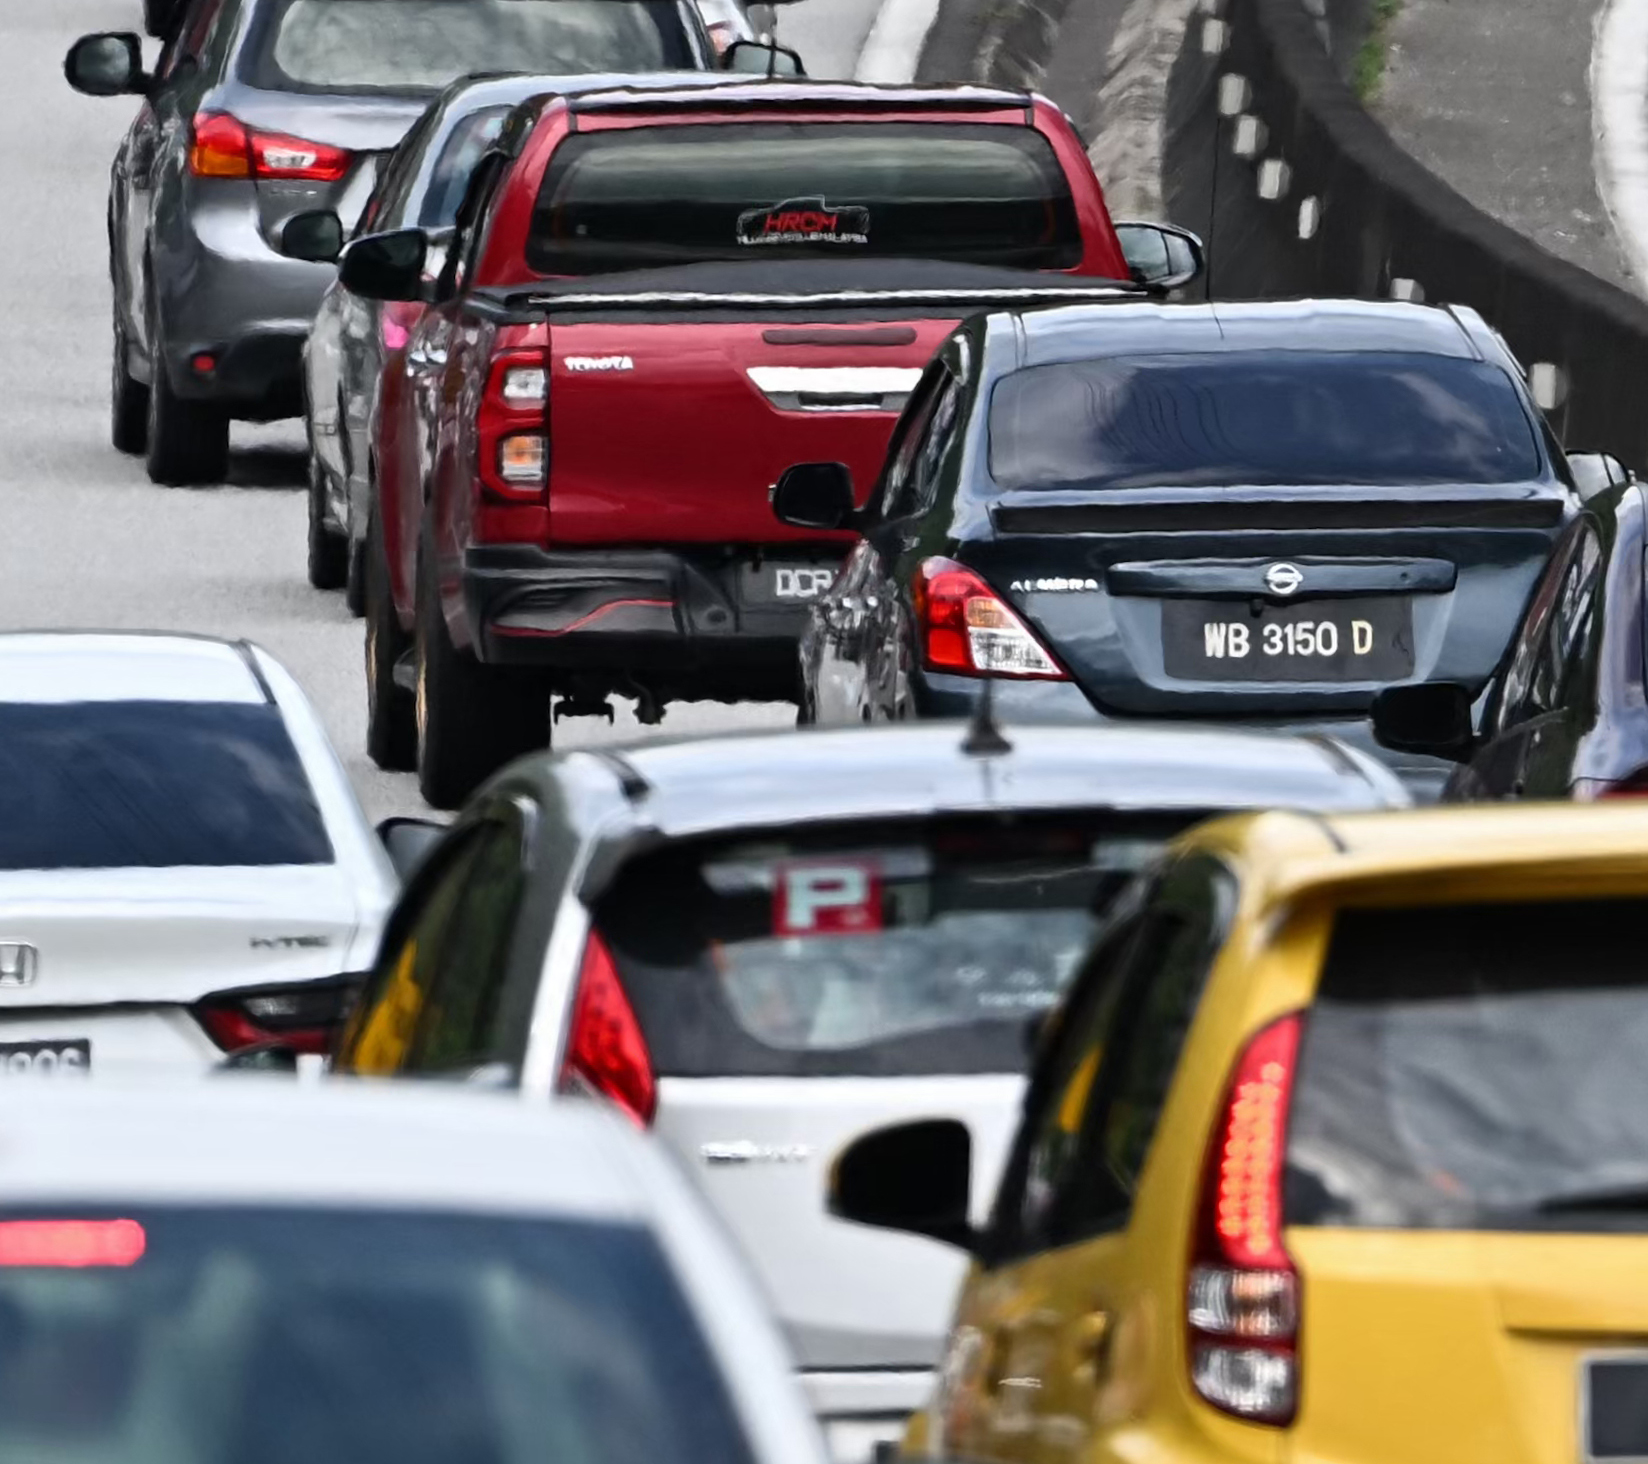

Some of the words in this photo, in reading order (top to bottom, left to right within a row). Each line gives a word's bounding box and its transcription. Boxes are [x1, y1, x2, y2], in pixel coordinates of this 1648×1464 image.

[1204, 622, 1250, 658] WB
[1262, 620, 1338, 656] 3150
[1351, 620, 1373, 655] D
[787, 867, 870, 929] P
